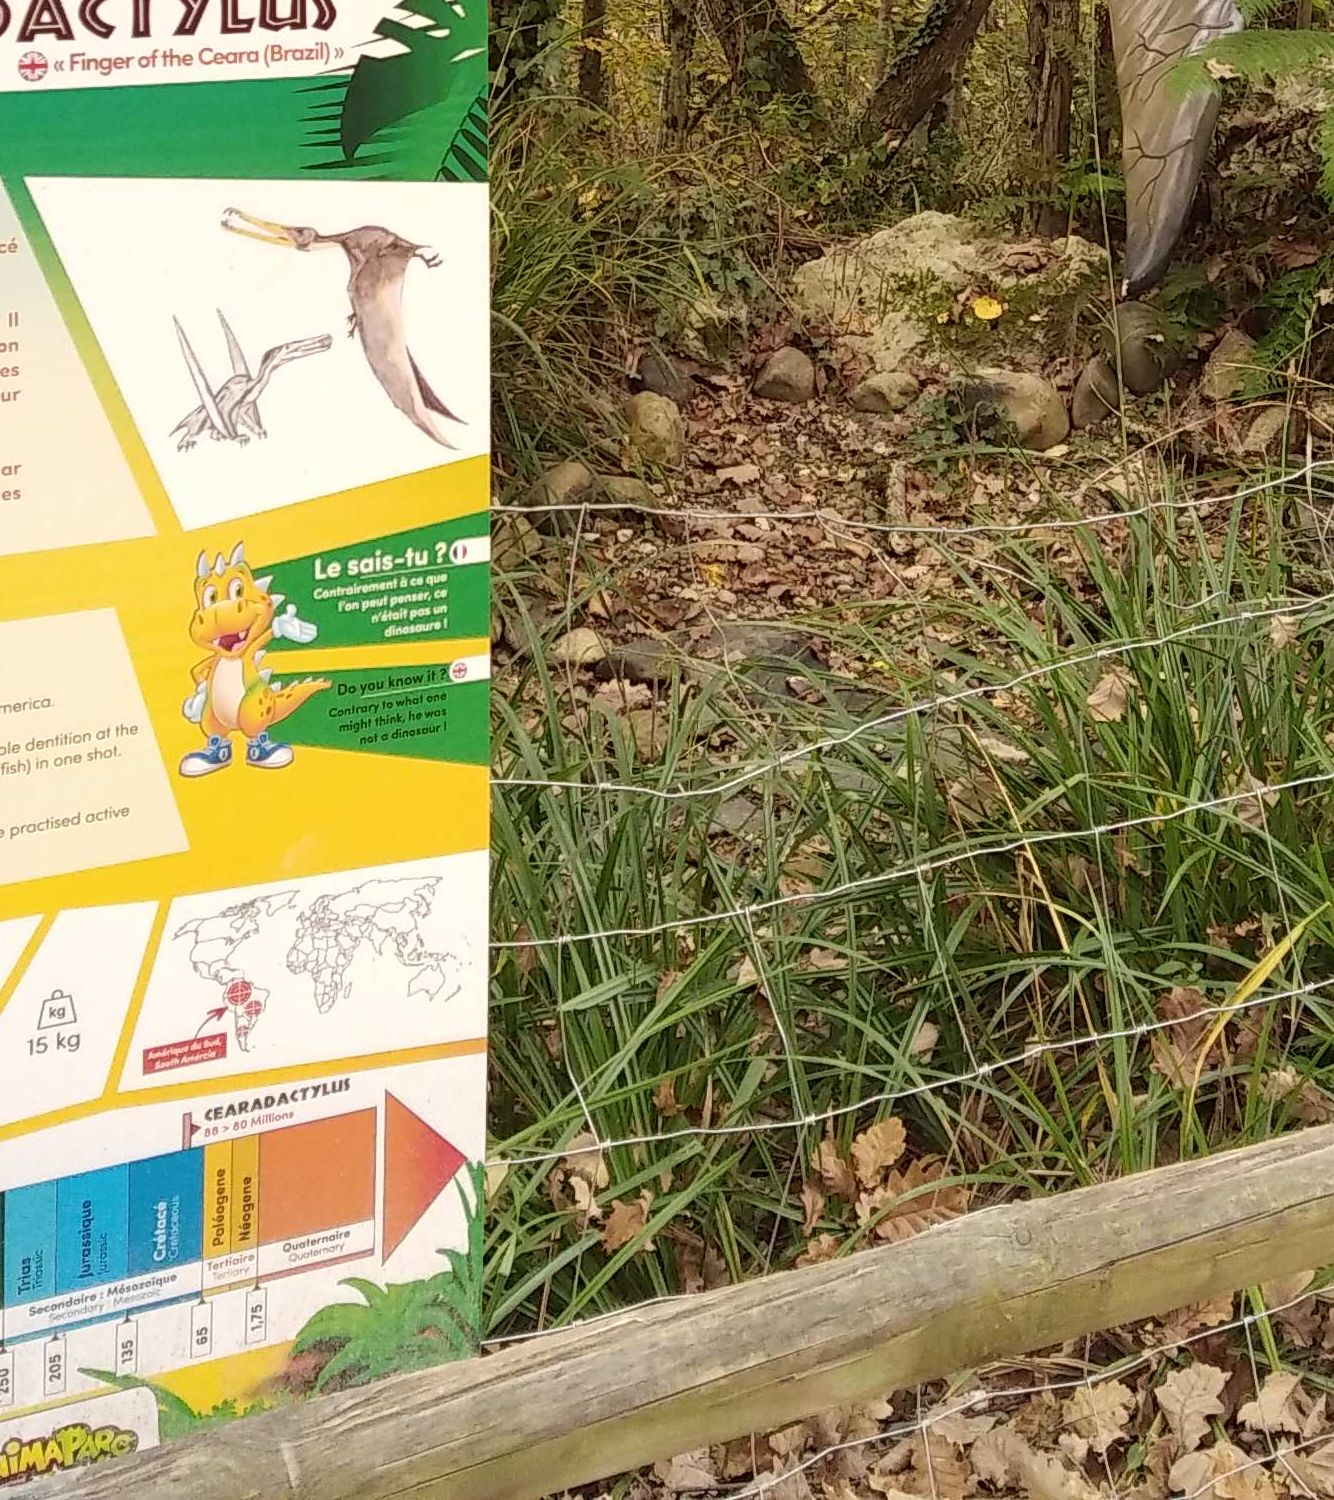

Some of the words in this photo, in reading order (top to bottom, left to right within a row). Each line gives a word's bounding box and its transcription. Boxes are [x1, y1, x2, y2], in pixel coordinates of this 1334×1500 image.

[69, 51, 135, 76] Finger
[137, 48, 159, 68] of
[160, 47, 194, 67] the
[197, 46, 259, 65] Ceara
[263, 41, 330, 68] (Brazil)
[8, 310, 18, 328] Il
[315, 557, 342, 580] Le
[347, 547, 429, 576] sais-tu
[435, 541, 447, 564] ?
[313, 578, 398, 599] Contrairement
[399, 576, 408, 588] à
[410, 577, 423, 586] ce
[425, 573, 448, 587] que
[337, 683, 356, 696] Do
[360, 681, 384, 695] you
[388, 676, 424, 688] know
[427, 669, 437, 682] it
[439, 668, 447, 680] ?
[49, 1006, 66, 1019] kg
[27, 1036, 49, 1056] 15
[56, 1031, 81, 1052] kg
[204, 1077, 352, 1122] CEARADACTYLUS
[204, 1125, 219, 1138] 88
[250, 1110, 295, 1128] Millions
[77, 1200, 95, 1279] Jurassique
[282, 1230, 351, 1253] Quaternaire
[206, 1252, 255, 1272] Tertiaire
[288, 1243, 346, 1263] Quaternary
[17, 1257, 31, 1295] Trias
[28, 1291, 97, 1317] Secondaire
[251, 1304, 264, 1331] 1,75
[196, 1326, 209, 1346] 65
[120, 1339, 134, 1365] 135
[49, 1354, 62, 1383] 205
